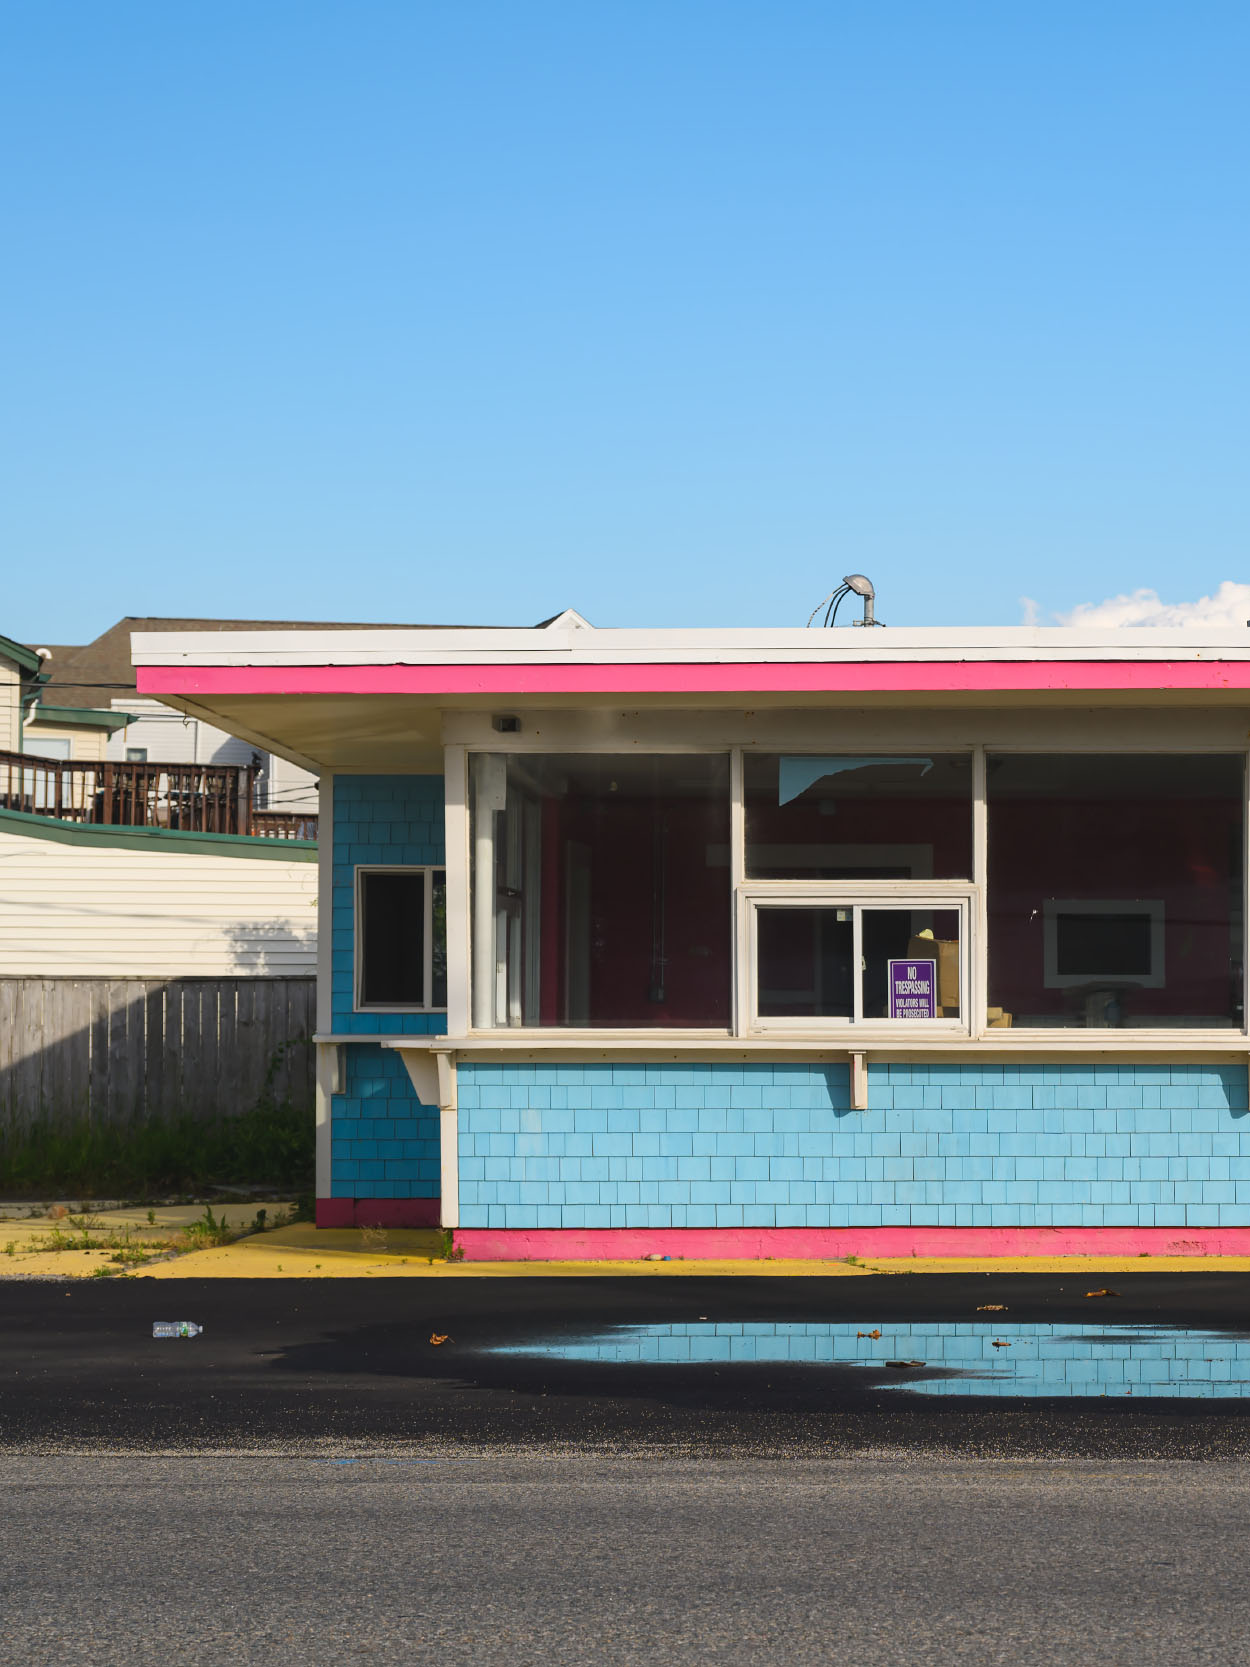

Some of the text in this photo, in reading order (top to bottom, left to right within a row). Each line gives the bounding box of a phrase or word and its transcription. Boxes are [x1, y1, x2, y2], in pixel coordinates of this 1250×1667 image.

[907, 966, 917, 980] NO
[895, 980, 930, 995] TRESPASSING
[895, 998, 929, 1008] VIOLATORS WILL
[896, 1009, 929, 1018] BE PROSECUTED
